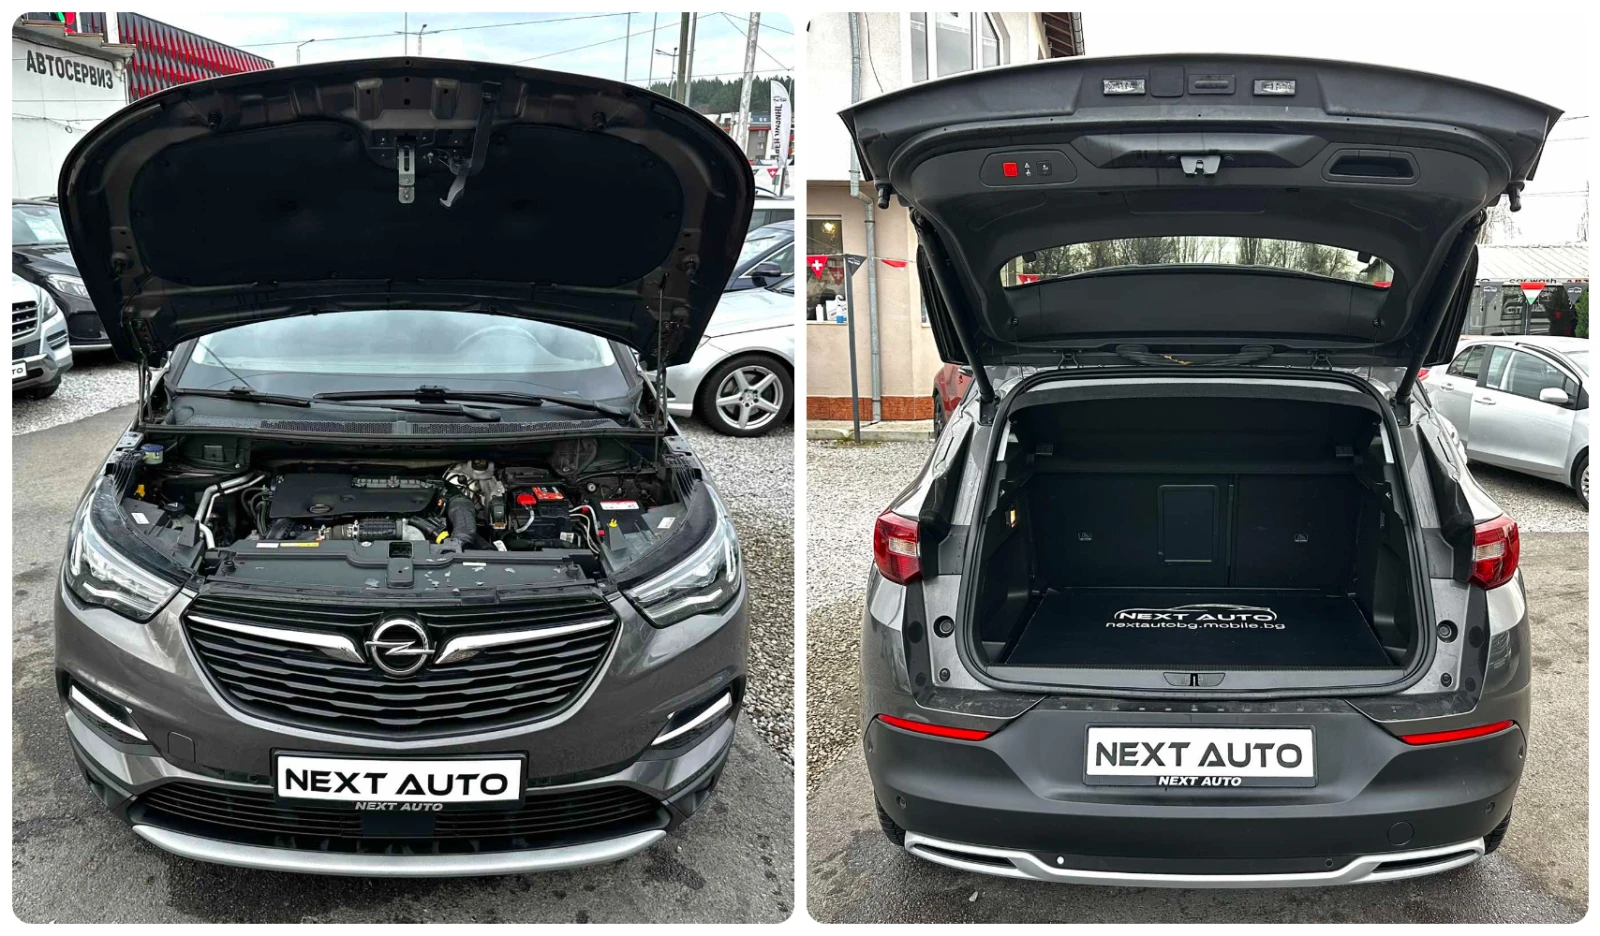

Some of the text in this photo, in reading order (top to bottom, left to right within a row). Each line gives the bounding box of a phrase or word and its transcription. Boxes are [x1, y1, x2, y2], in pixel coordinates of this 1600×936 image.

[26, 49, 114, 90] АВТОСЕРВИЗ
[1118, 612, 1273, 622] NEXT AUTO
[1105, 621, 1286, 630] nextautobg.mobile.bg
[1095, 741, 1303, 769] NEXT AUTO
[285, 768, 508, 797] NEXT AUTO
[1158, 776, 1242, 787] NEXT AUTO
[354, 801, 444, 812] NEXT AUTO
